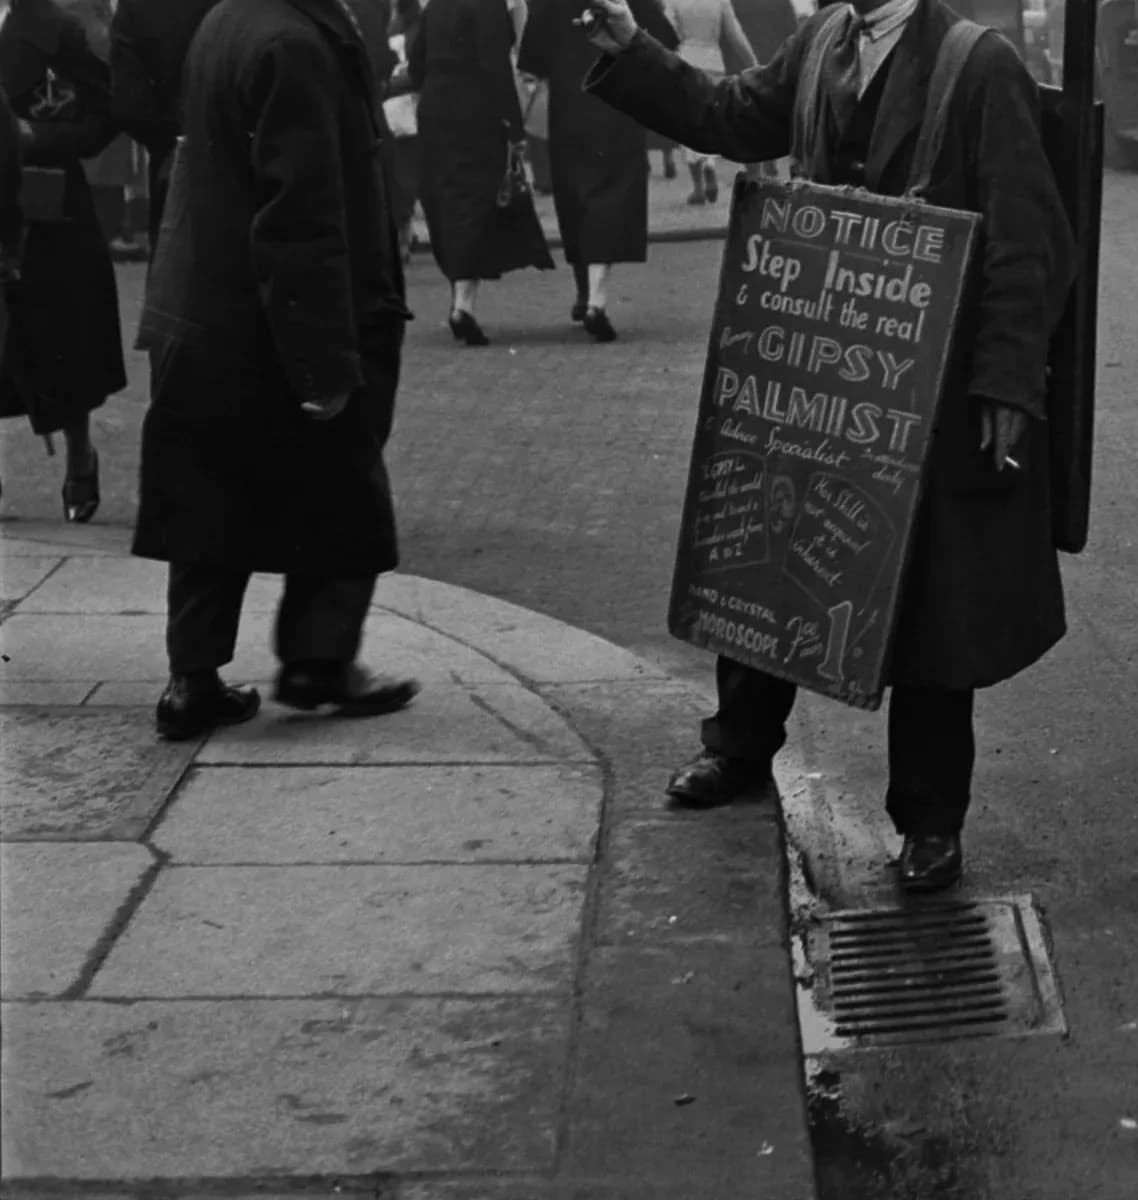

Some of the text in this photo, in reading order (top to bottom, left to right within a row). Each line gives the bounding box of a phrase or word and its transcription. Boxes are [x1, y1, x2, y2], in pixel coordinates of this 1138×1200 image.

[759, 198, 945, 264] NOTICE
[741, 234, 932, 308] Step Inside
[760, 289, 834, 323] consult
[840, 297, 868, 330] the
[875, 309, 927, 344] real
[757, 325, 916, 391] GIPSY
[714, 366, 923, 453] PALMIST
[700, 607, 780, 659] HOROSCOPE
[727, 595, 778, 624] CRYSTAL
